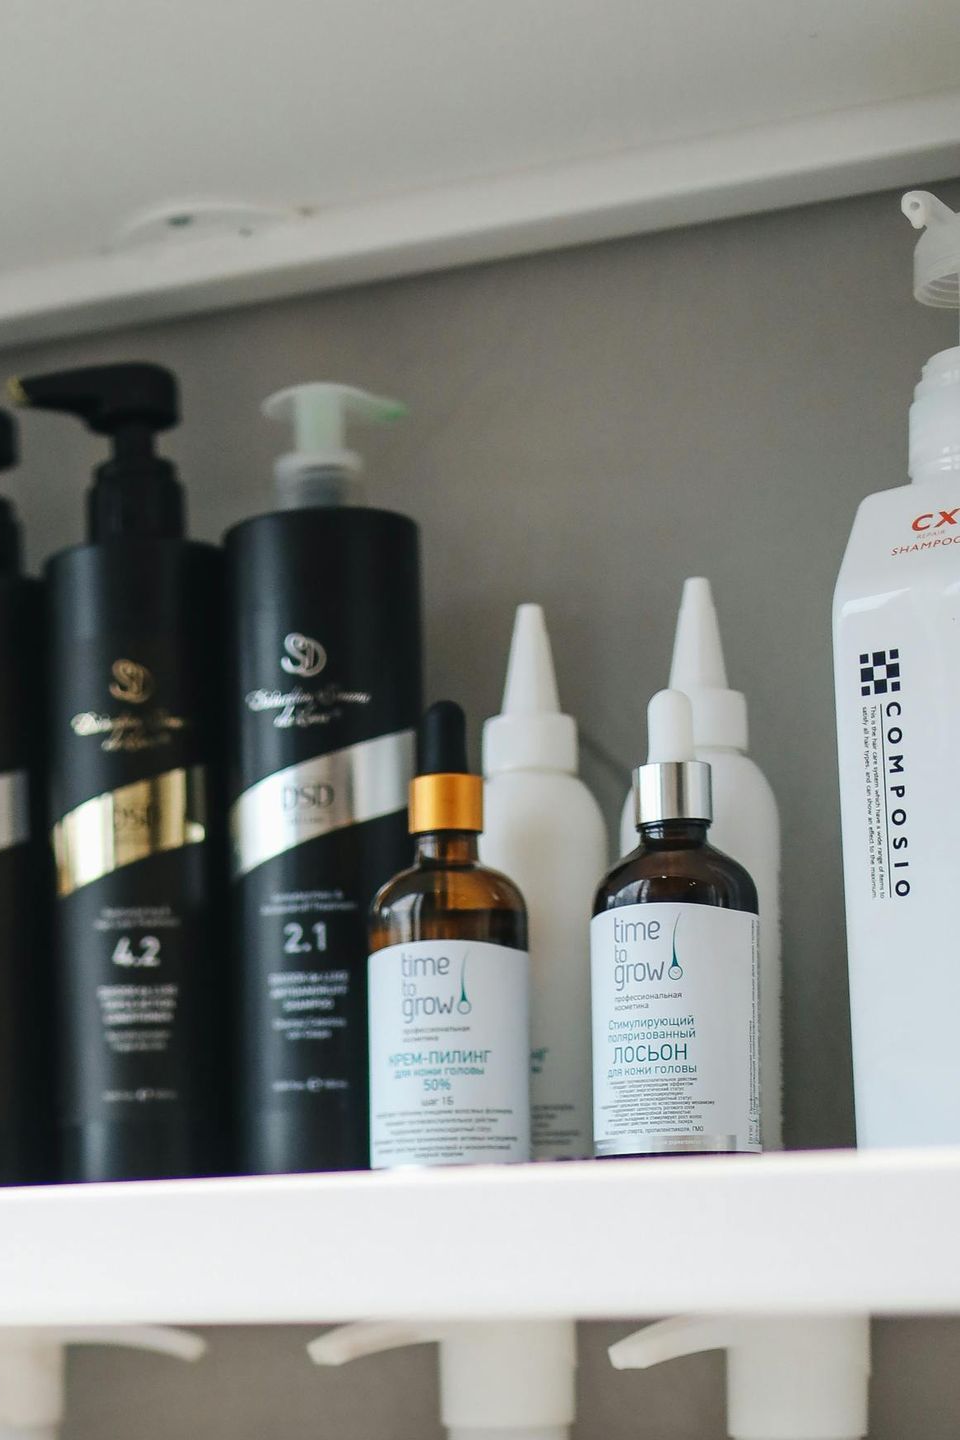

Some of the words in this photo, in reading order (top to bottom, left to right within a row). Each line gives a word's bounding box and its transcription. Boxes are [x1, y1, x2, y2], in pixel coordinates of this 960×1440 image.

[886, 702, 910, 897] COMPOSIO
[284, 922, 327, 953] 2.1
[614, 917, 661, 943] time
[614, 944, 627, 963] to
[401, 954, 450, 977] time
[614, 961, 665, 992] grow
[402, 996, 454, 1024] grow
[608, 1015, 695, 1031] Стимулирующий
[608, 1028, 696, 1044] поляризованный
[613, 1043, 688, 1064] ЛОСЬОН
[624, 1066, 652, 1076] кожи
[655, 1065, 697, 1075] головы
